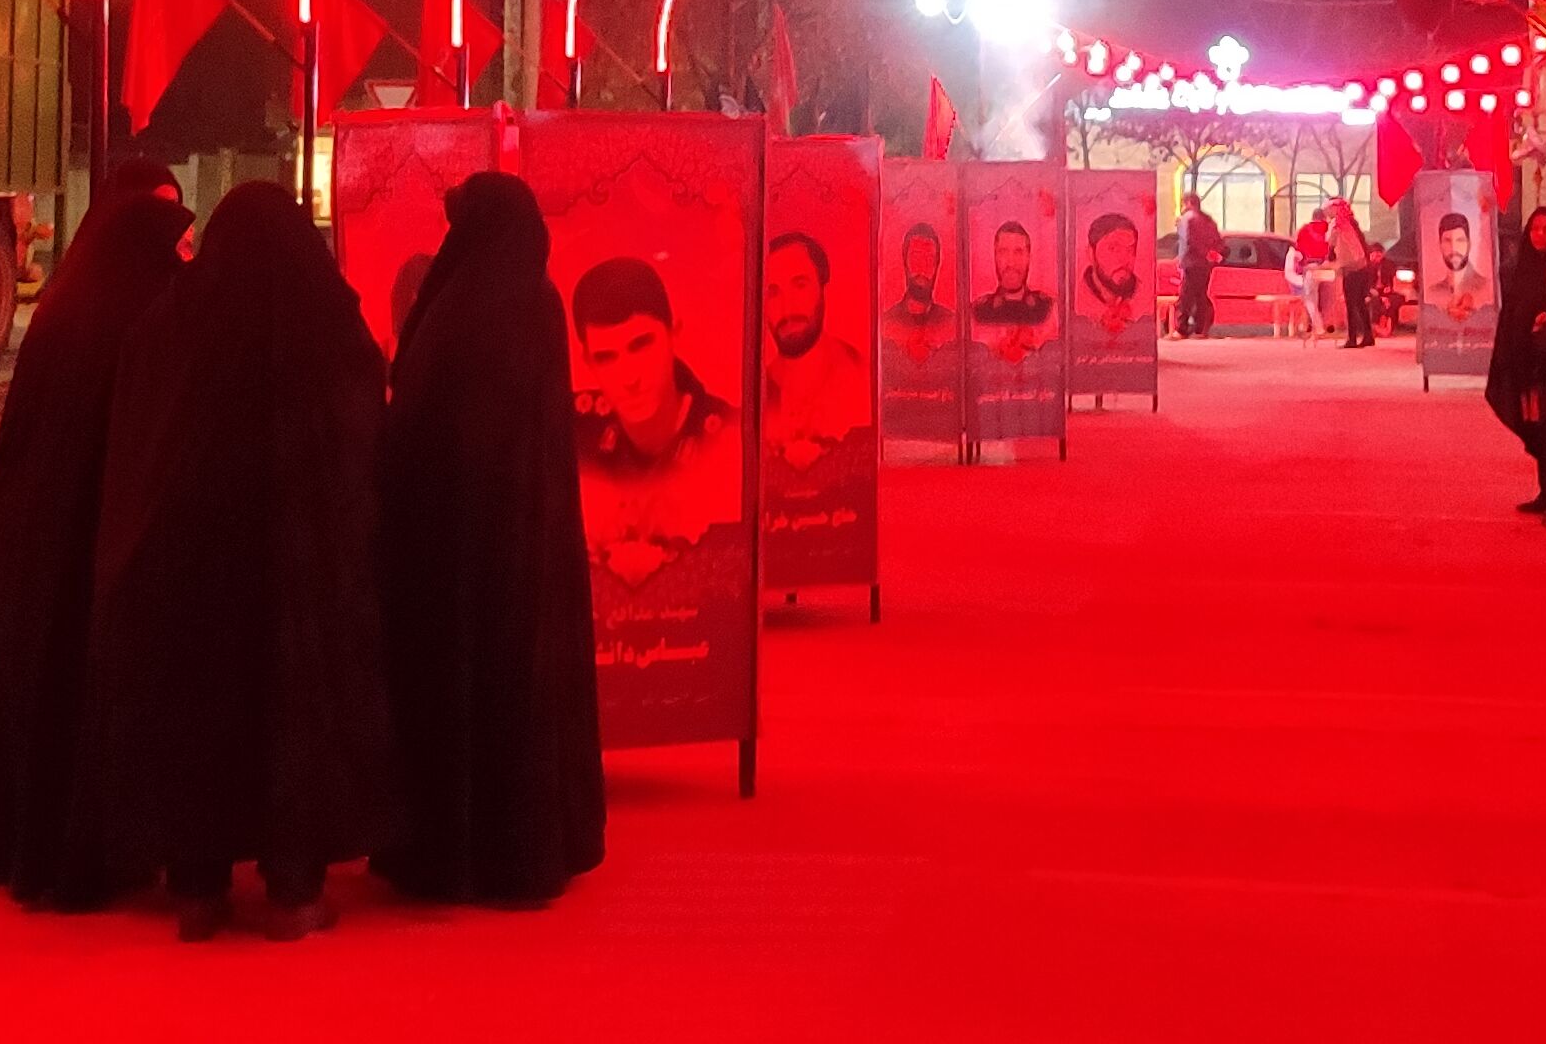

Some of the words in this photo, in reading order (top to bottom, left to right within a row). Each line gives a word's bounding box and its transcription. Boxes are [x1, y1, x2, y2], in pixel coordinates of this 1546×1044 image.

[765, 510, 789, 533] خرا
[606, 603, 654, 630] مدافع
[636, 637, 710, 670] عباس
